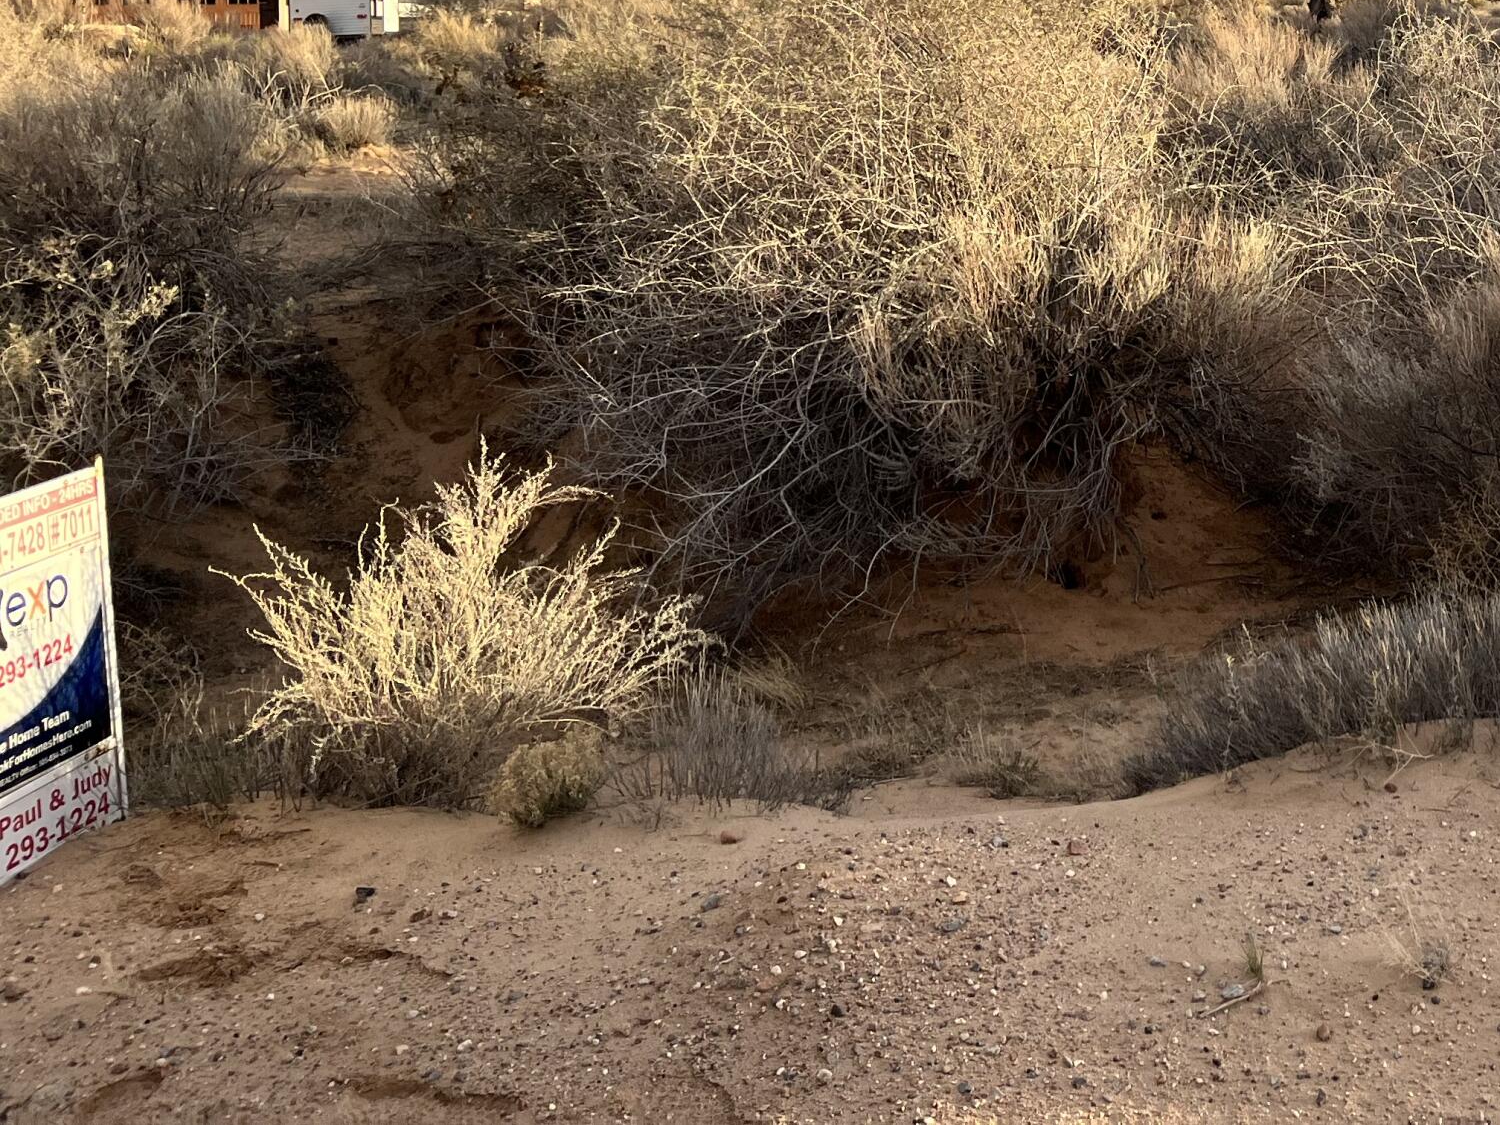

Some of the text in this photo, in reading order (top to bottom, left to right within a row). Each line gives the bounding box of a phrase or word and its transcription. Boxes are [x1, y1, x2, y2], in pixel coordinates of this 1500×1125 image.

[22, 494, 50, 516] INFO
[59, 479, 94, 504] 24HRS
[51, 505, 93, 545] #7011
[8, 725, 40, 749] Home
[41, 710, 70, 731] Team
[0, 798, 42, 840] Paul
[49, 788, 65, 811] &
[72, 764, 112, 800] Judy
[6, 791, 110, 871] 293-1224
